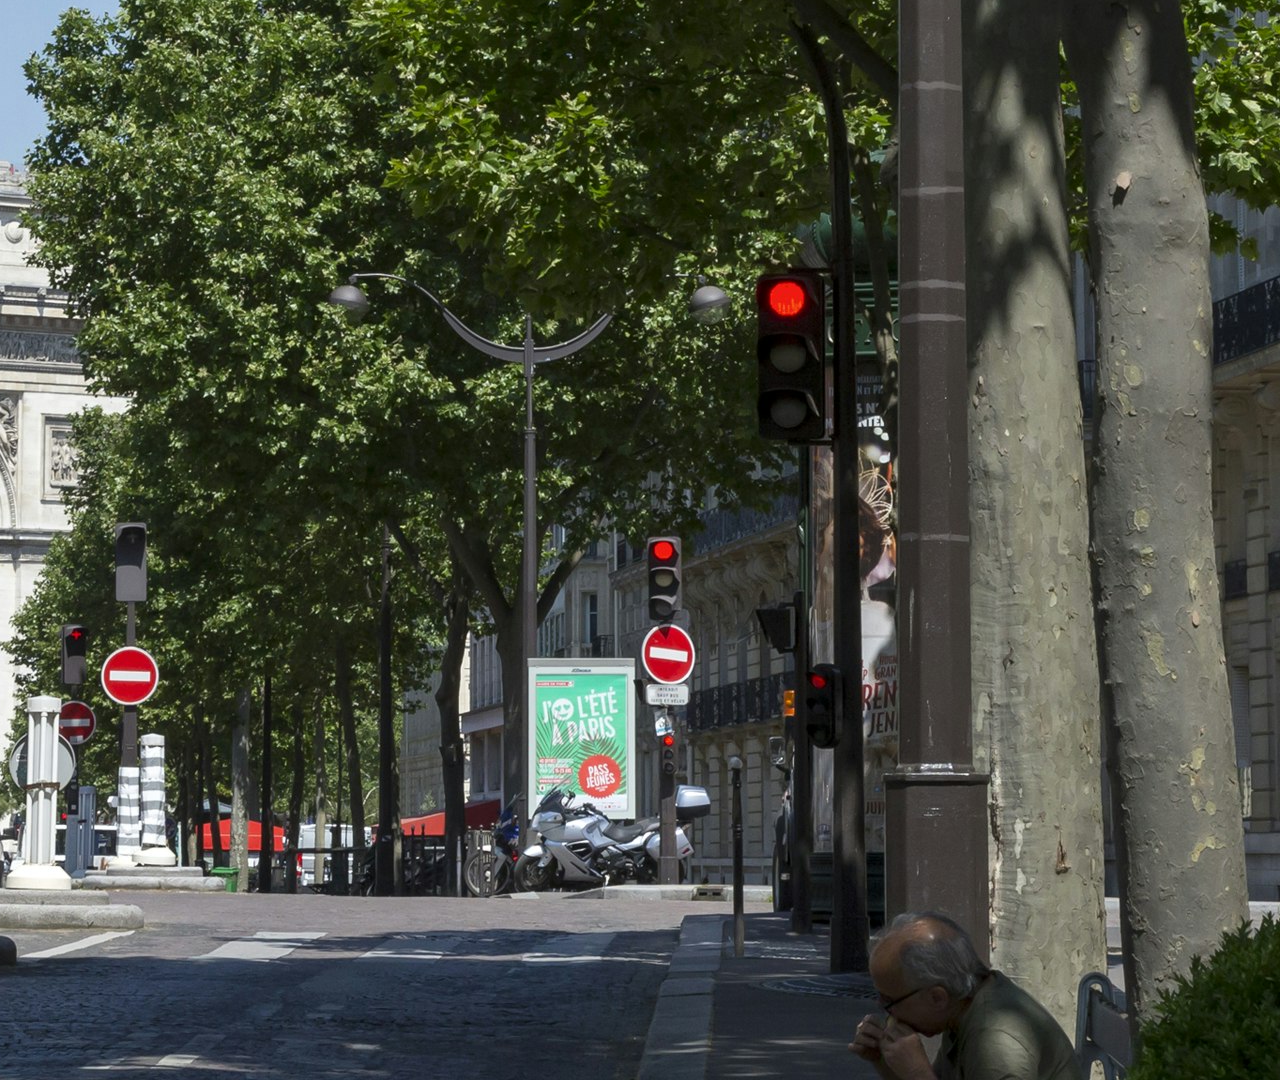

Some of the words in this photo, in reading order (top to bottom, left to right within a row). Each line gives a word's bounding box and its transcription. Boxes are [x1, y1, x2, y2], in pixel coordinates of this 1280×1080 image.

[577, 686, 618, 718] L'ÉTÉ
[567, 716, 616, 744] PARIS
[586, 773, 616, 788] JEUNES
[587, 763, 610, 777] PASS
